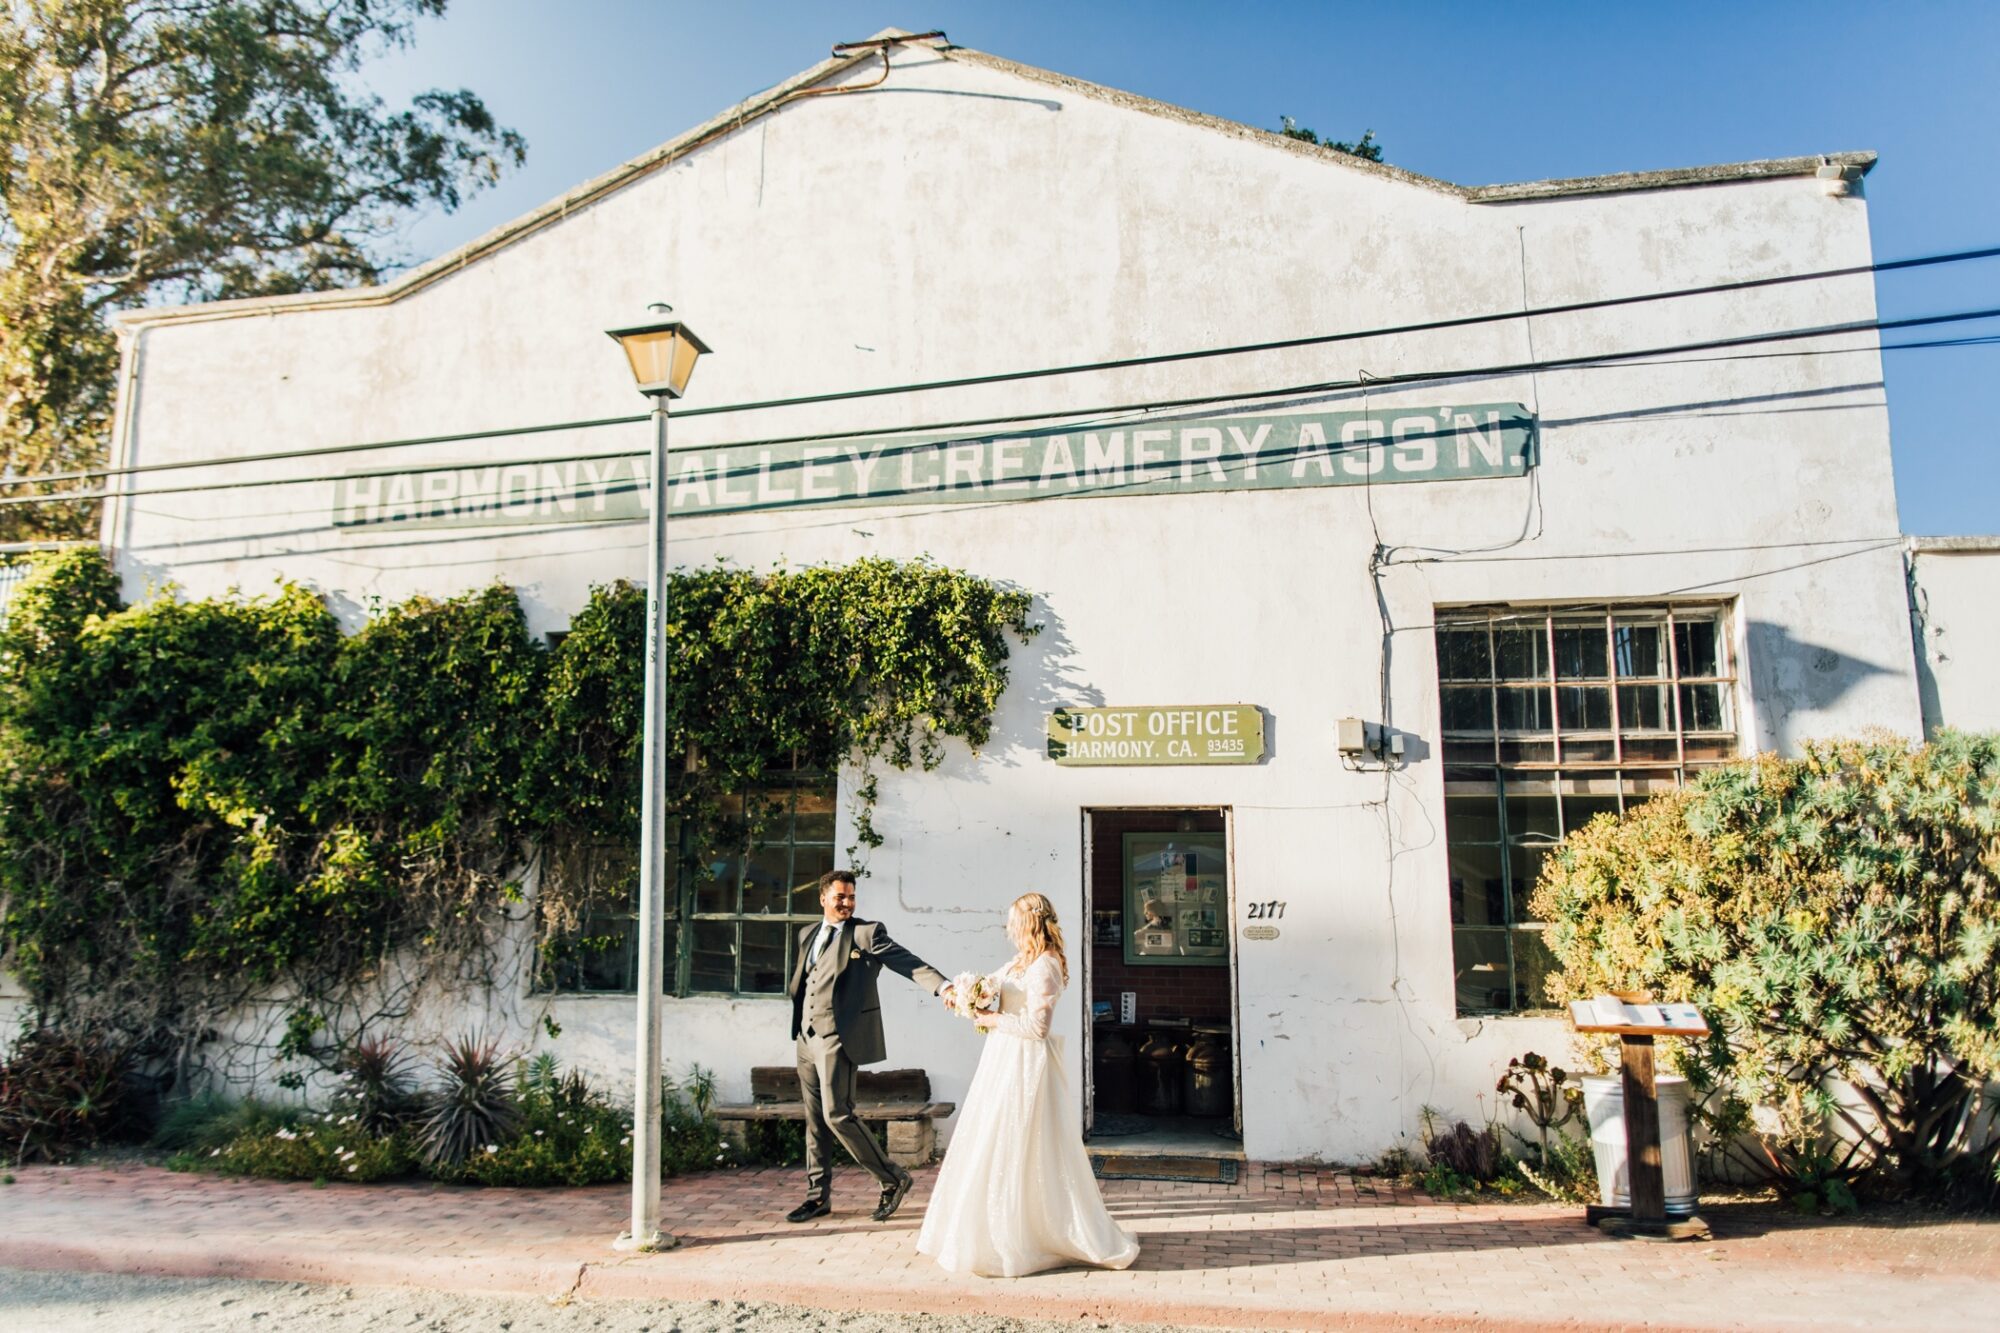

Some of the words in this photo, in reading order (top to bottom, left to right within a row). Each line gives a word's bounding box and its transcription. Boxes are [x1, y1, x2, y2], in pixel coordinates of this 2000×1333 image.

[344, 459, 620, 525] HARMONY
[903, 426, 1273, 495] CREAMERY
[1070, 713, 1138, 737] POST
[1148, 711, 1238, 736] OFFICE
[1167, 740, 1198, 757] CA.
[1208, 739, 1244, 752] 93435
[1247, 900, 1287, 919] 2177
